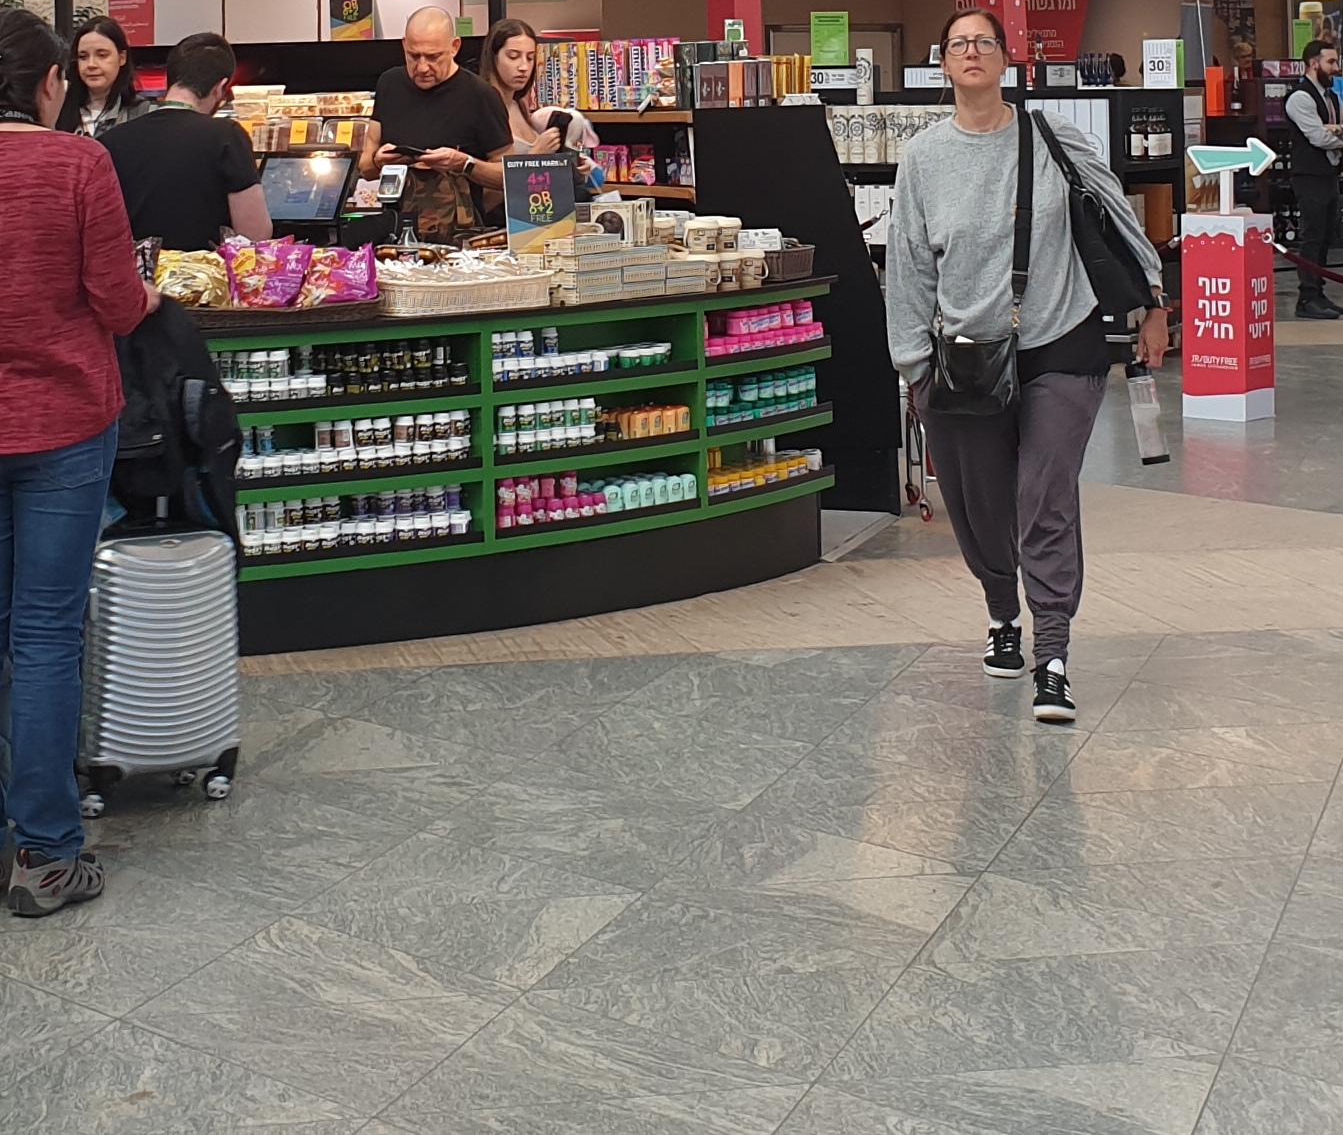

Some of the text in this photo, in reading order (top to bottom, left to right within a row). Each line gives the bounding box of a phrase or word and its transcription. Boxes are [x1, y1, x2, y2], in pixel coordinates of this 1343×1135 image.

[1149, 60, 1164, 72] 30
[1198, 277, 1230, 296] סוף
[1198, 299, 1230, 319] סוף
